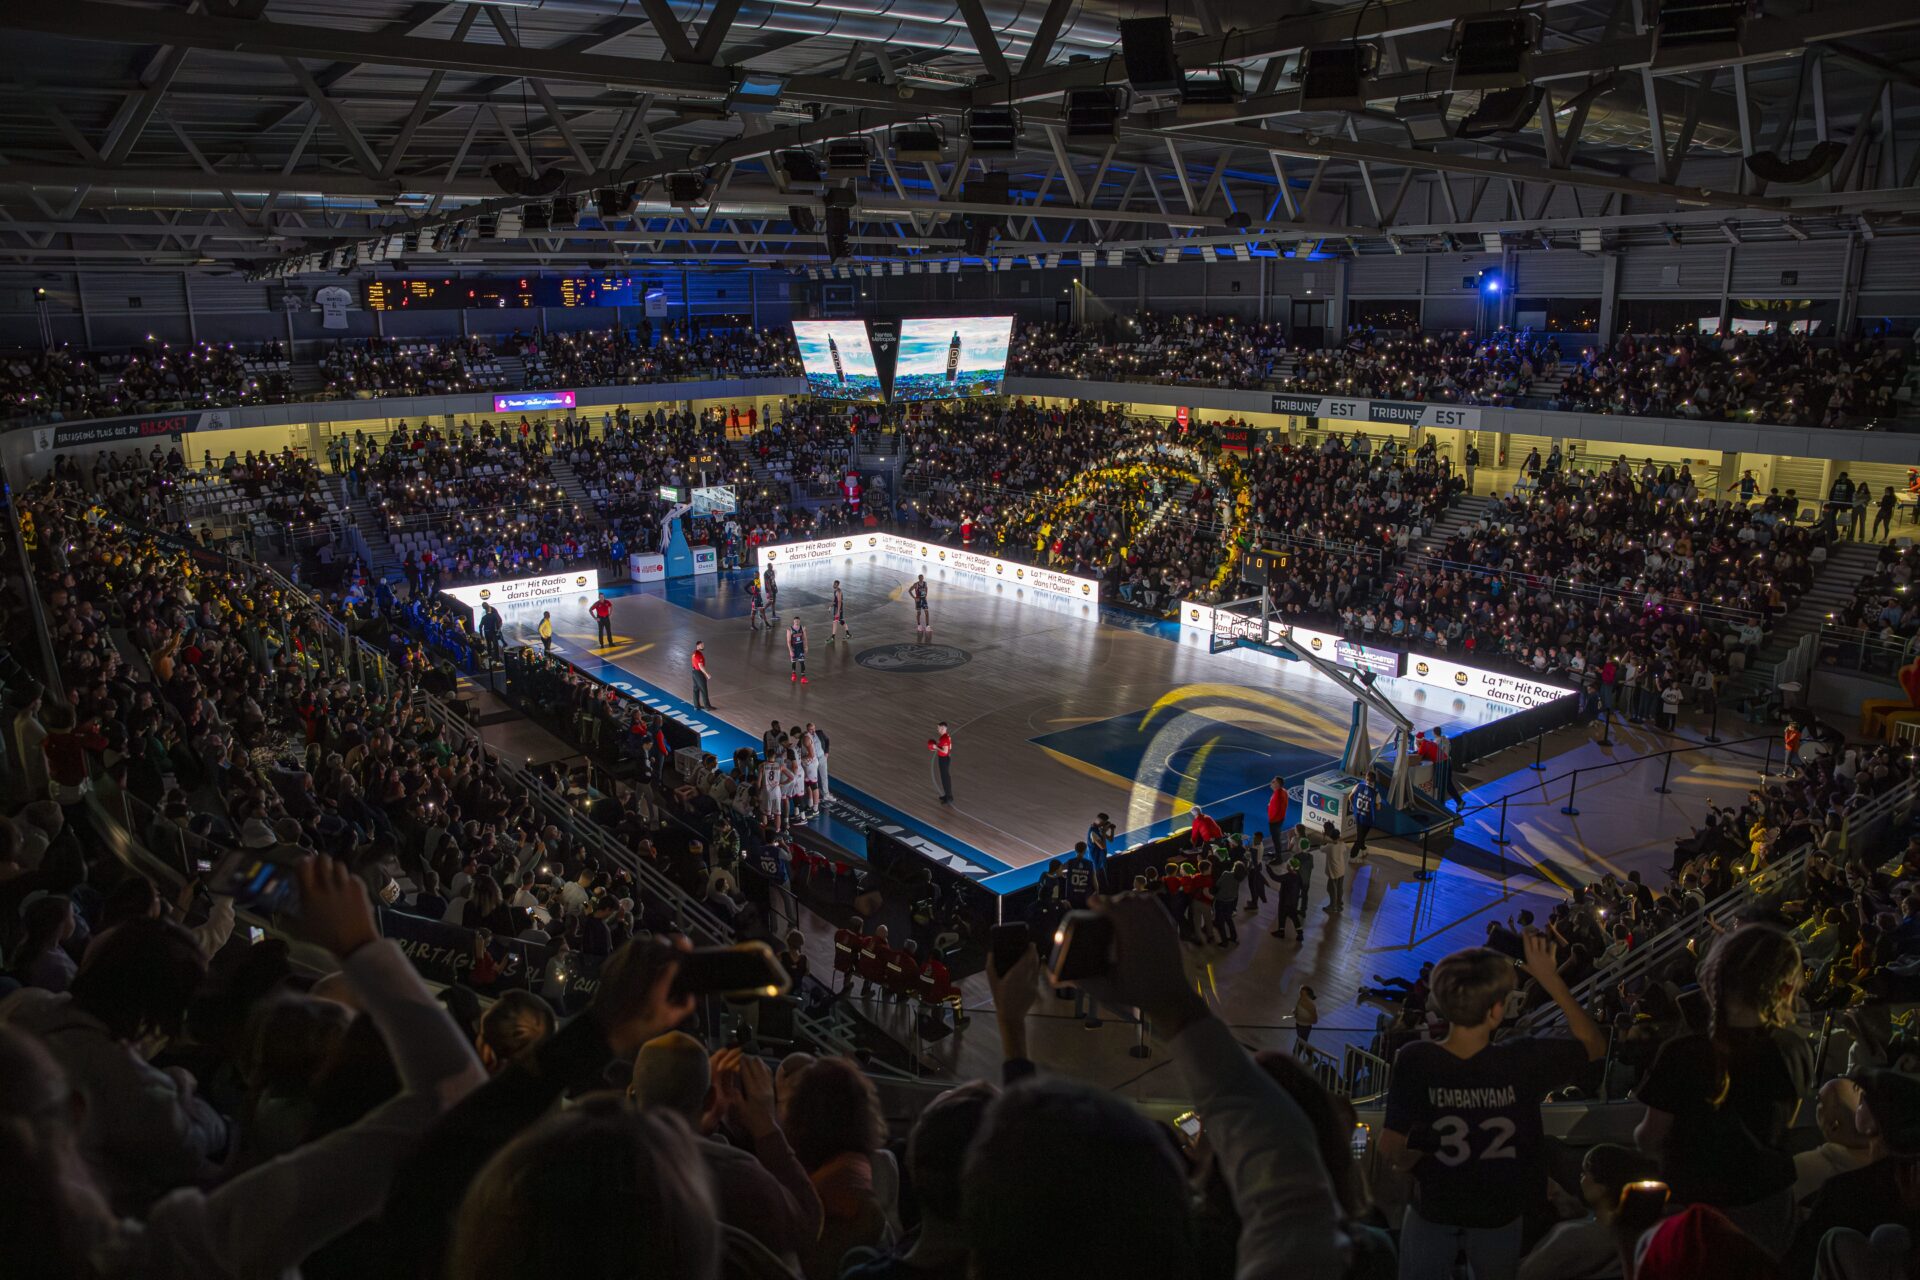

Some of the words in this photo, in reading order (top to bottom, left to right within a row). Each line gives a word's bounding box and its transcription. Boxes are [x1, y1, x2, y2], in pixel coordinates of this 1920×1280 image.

[1274, 400, 1318, 412] TRIBUNE
[1330, 402, 1357, 417] EST
[1371, 406, 1422, 421] TRIBUNE
[1435, 411, 1466, 425] EST
[139, 416, 188, 436] BASKET
[816, 541, 837, 549] Radio
[501, 584, 513, 592] La
[542, 577, 567, 586] Radio
[507, 590, 529, 600] dans
[1358, 651, 1395, 666] LANCASTER
[1481, 674, 1496, 686] La
[1515, 682, 1532, 694] Hit
[1533, 686, 1567, 701] Radi
[1487, 687, 1515, 702] dans
[768, 770, 775, 781] 8
[1309, 793, 1337, 812] CIC
[1071, 873, 1089, 887] 02
[1431, 1114, 1517, 1167] 32
